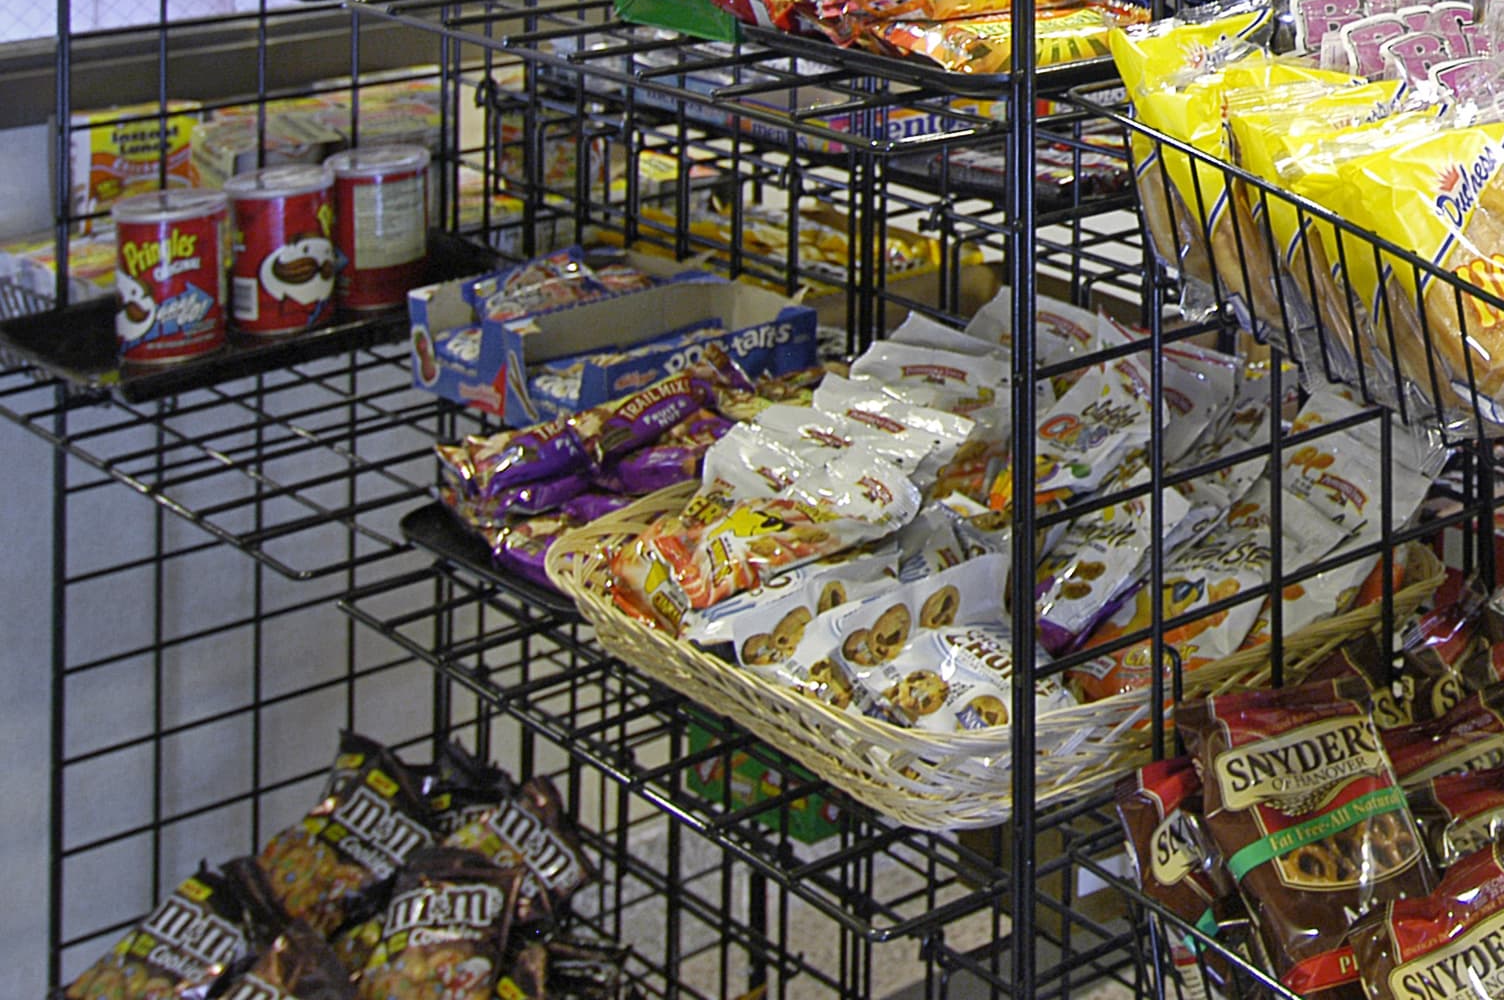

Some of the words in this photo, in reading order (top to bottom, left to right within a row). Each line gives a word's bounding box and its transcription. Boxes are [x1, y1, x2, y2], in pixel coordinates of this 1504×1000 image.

[122, 228, 198, 279] Pringles
[619, 387, 659, 421] TRAIL
[1226, 720, 1378, 793] SNYDER'S
[1294, 755, 1368, 788] HANOVER
[1269, 831, 1295, 851] Fat
